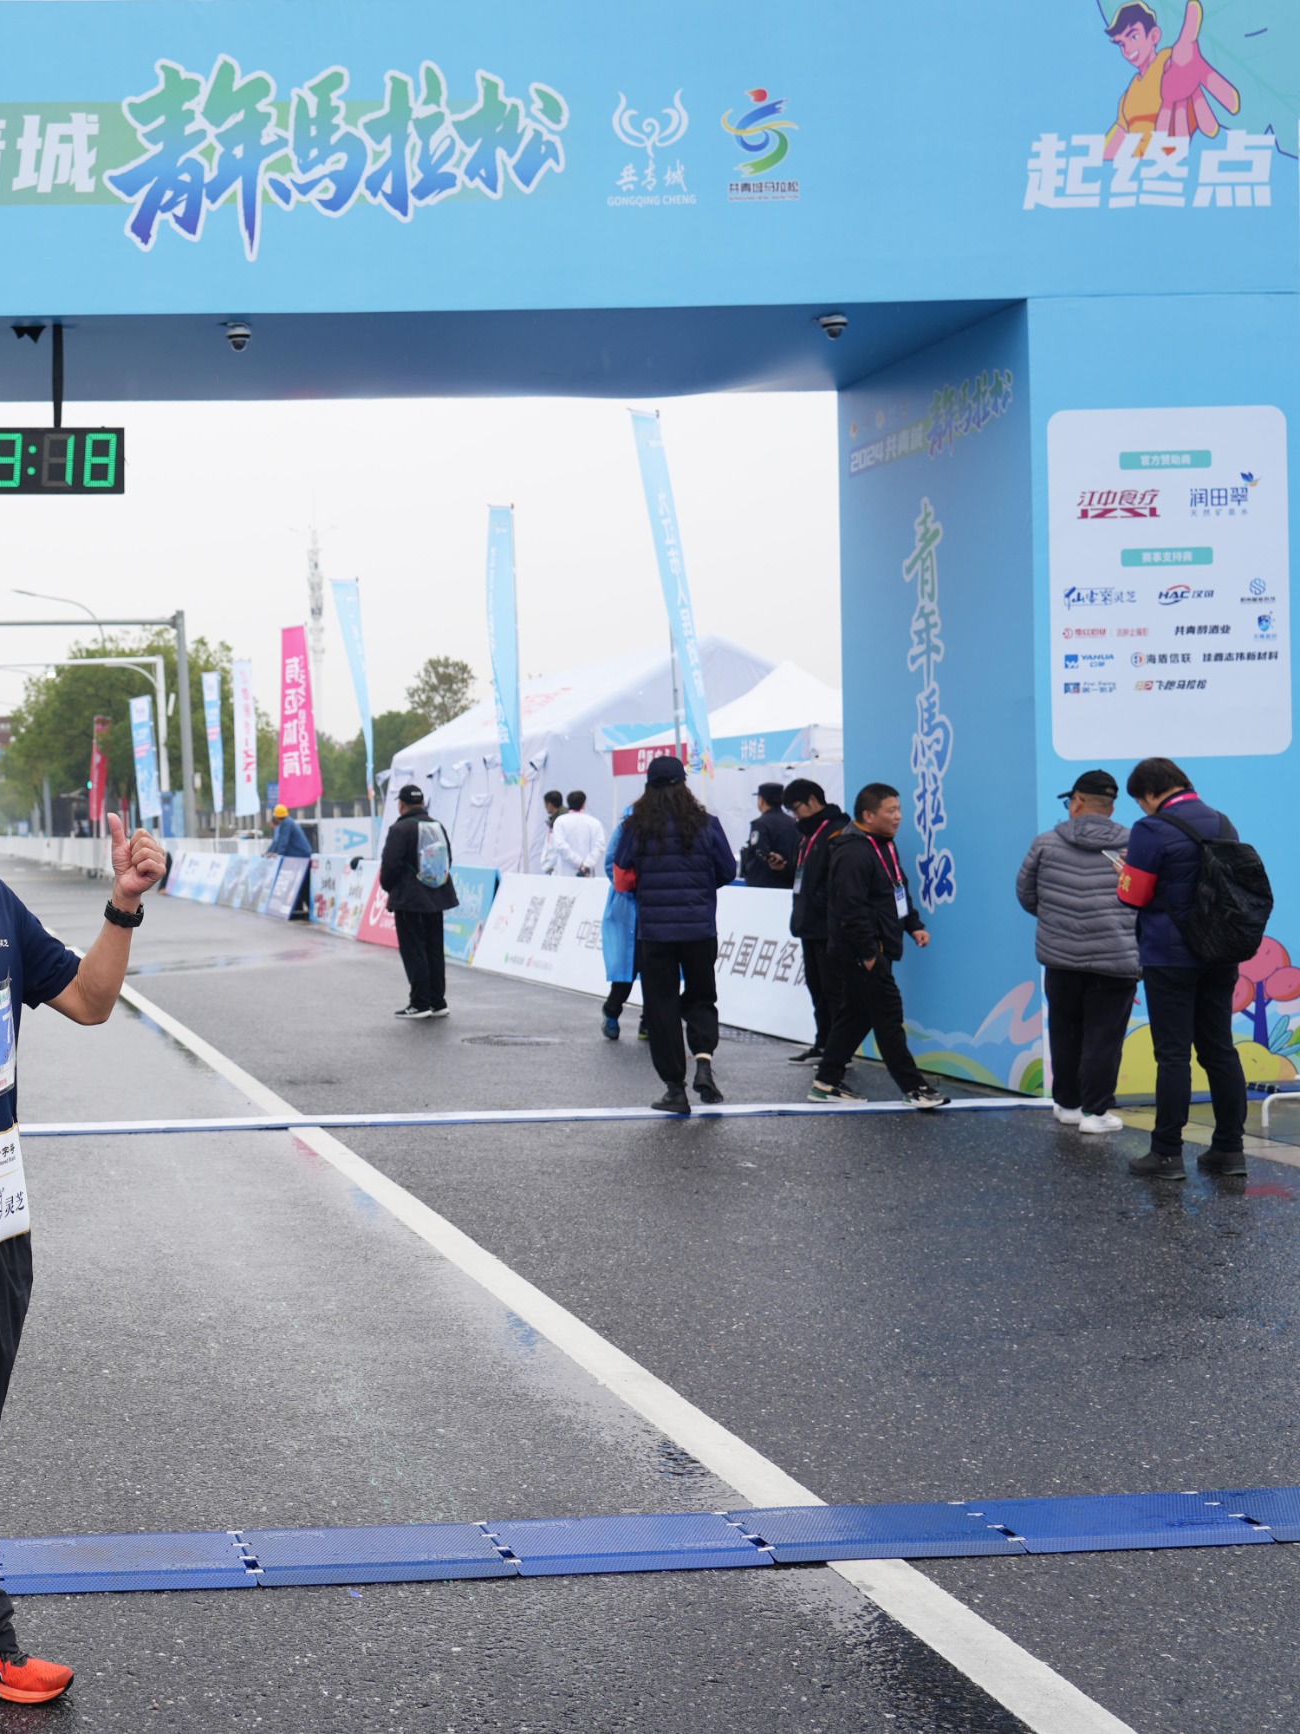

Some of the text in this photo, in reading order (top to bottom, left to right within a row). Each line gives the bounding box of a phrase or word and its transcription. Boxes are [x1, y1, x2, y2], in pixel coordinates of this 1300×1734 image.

[1022, 129, 1277, 211] 起终点
[607, 194, 697, 208] GONGQING CHENG
[1076, 488, 1160, 507] 江中食疗
[1189, 487, 1249, 508] 润田翠
[1158, 589, 1191, 600] HAC
[740, 738, 766, 762] 计时点
[575, 918, 604, 951] 中国
